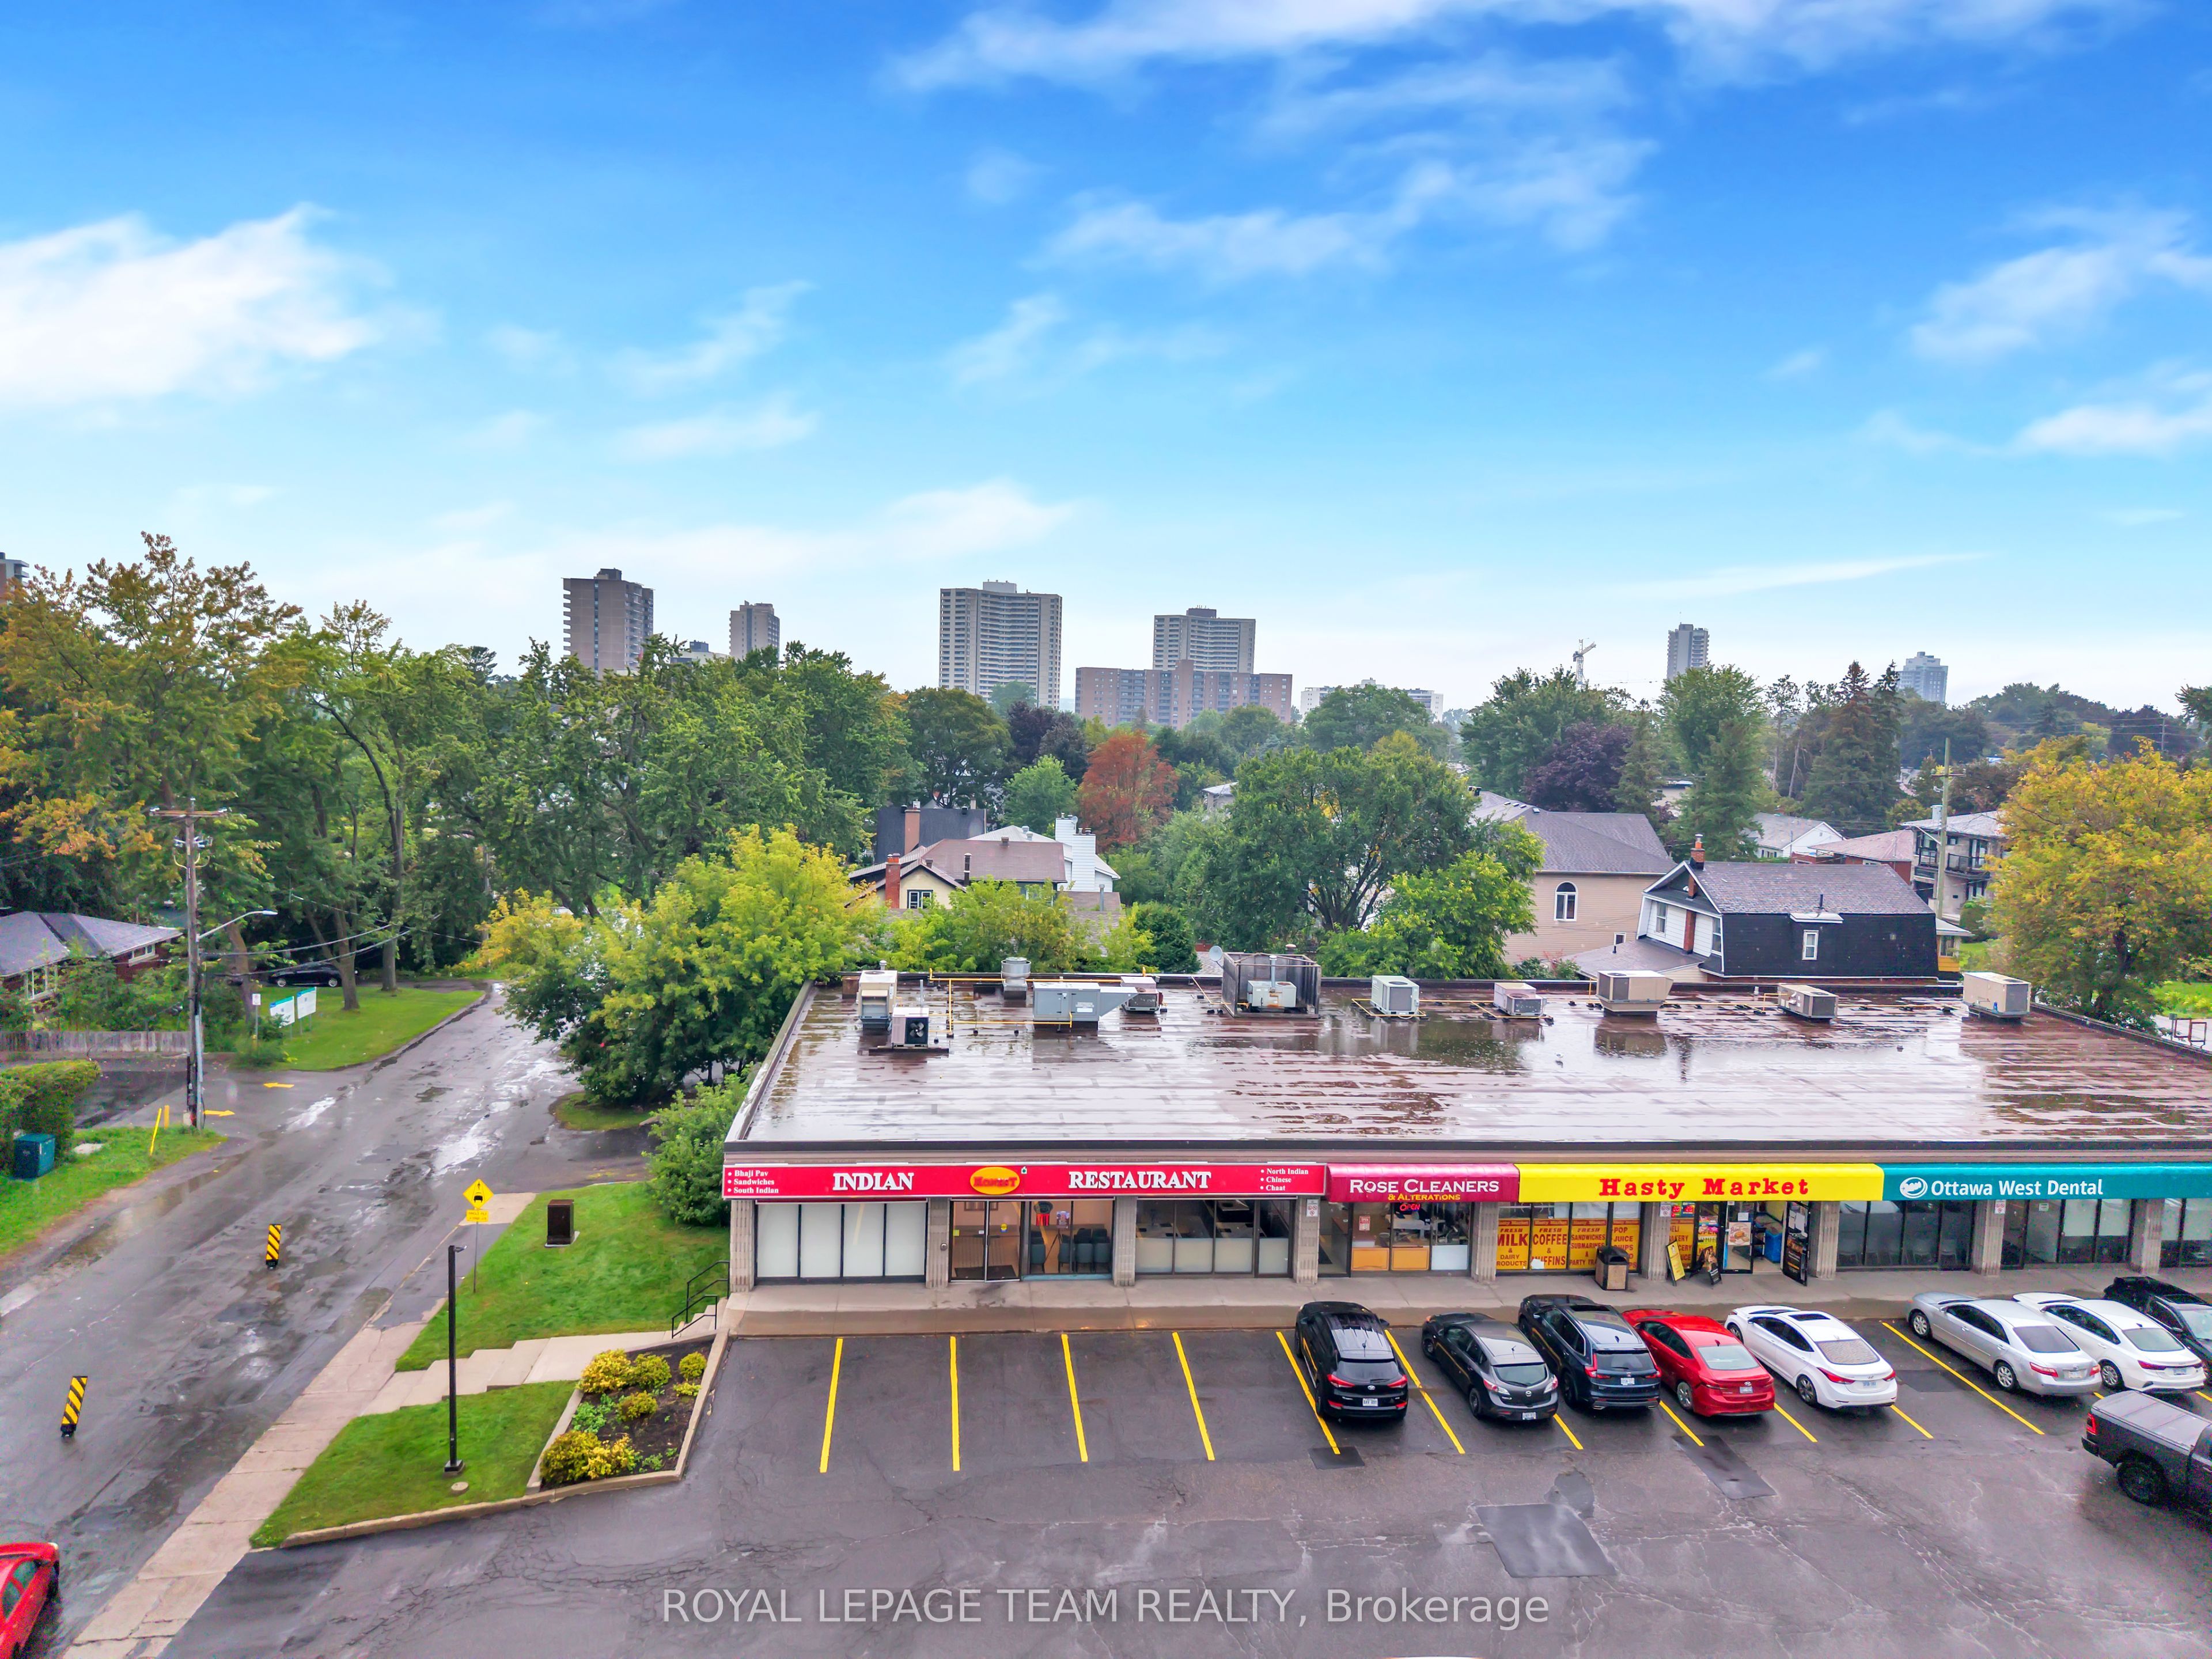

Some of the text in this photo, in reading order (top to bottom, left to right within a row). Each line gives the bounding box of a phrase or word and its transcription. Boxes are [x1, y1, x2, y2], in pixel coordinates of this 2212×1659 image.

[832, 1172, 914, 1191] INDIAN
[1069, 1171, 1211, 1189] RESTAURANT
[1350, 1179, 1499, 1193] ROSE CLEANERS
[1931, 1179, 2103, 1196] Ottawa West Dental
[1599, 1178, 1808, 1199] Hasty Market
[1498, 1233, 1528, 1246] MILK
[1533, 1234, 1567, 1245] COFFEE
[1532, 1256, 1566, 1266] FFINS
